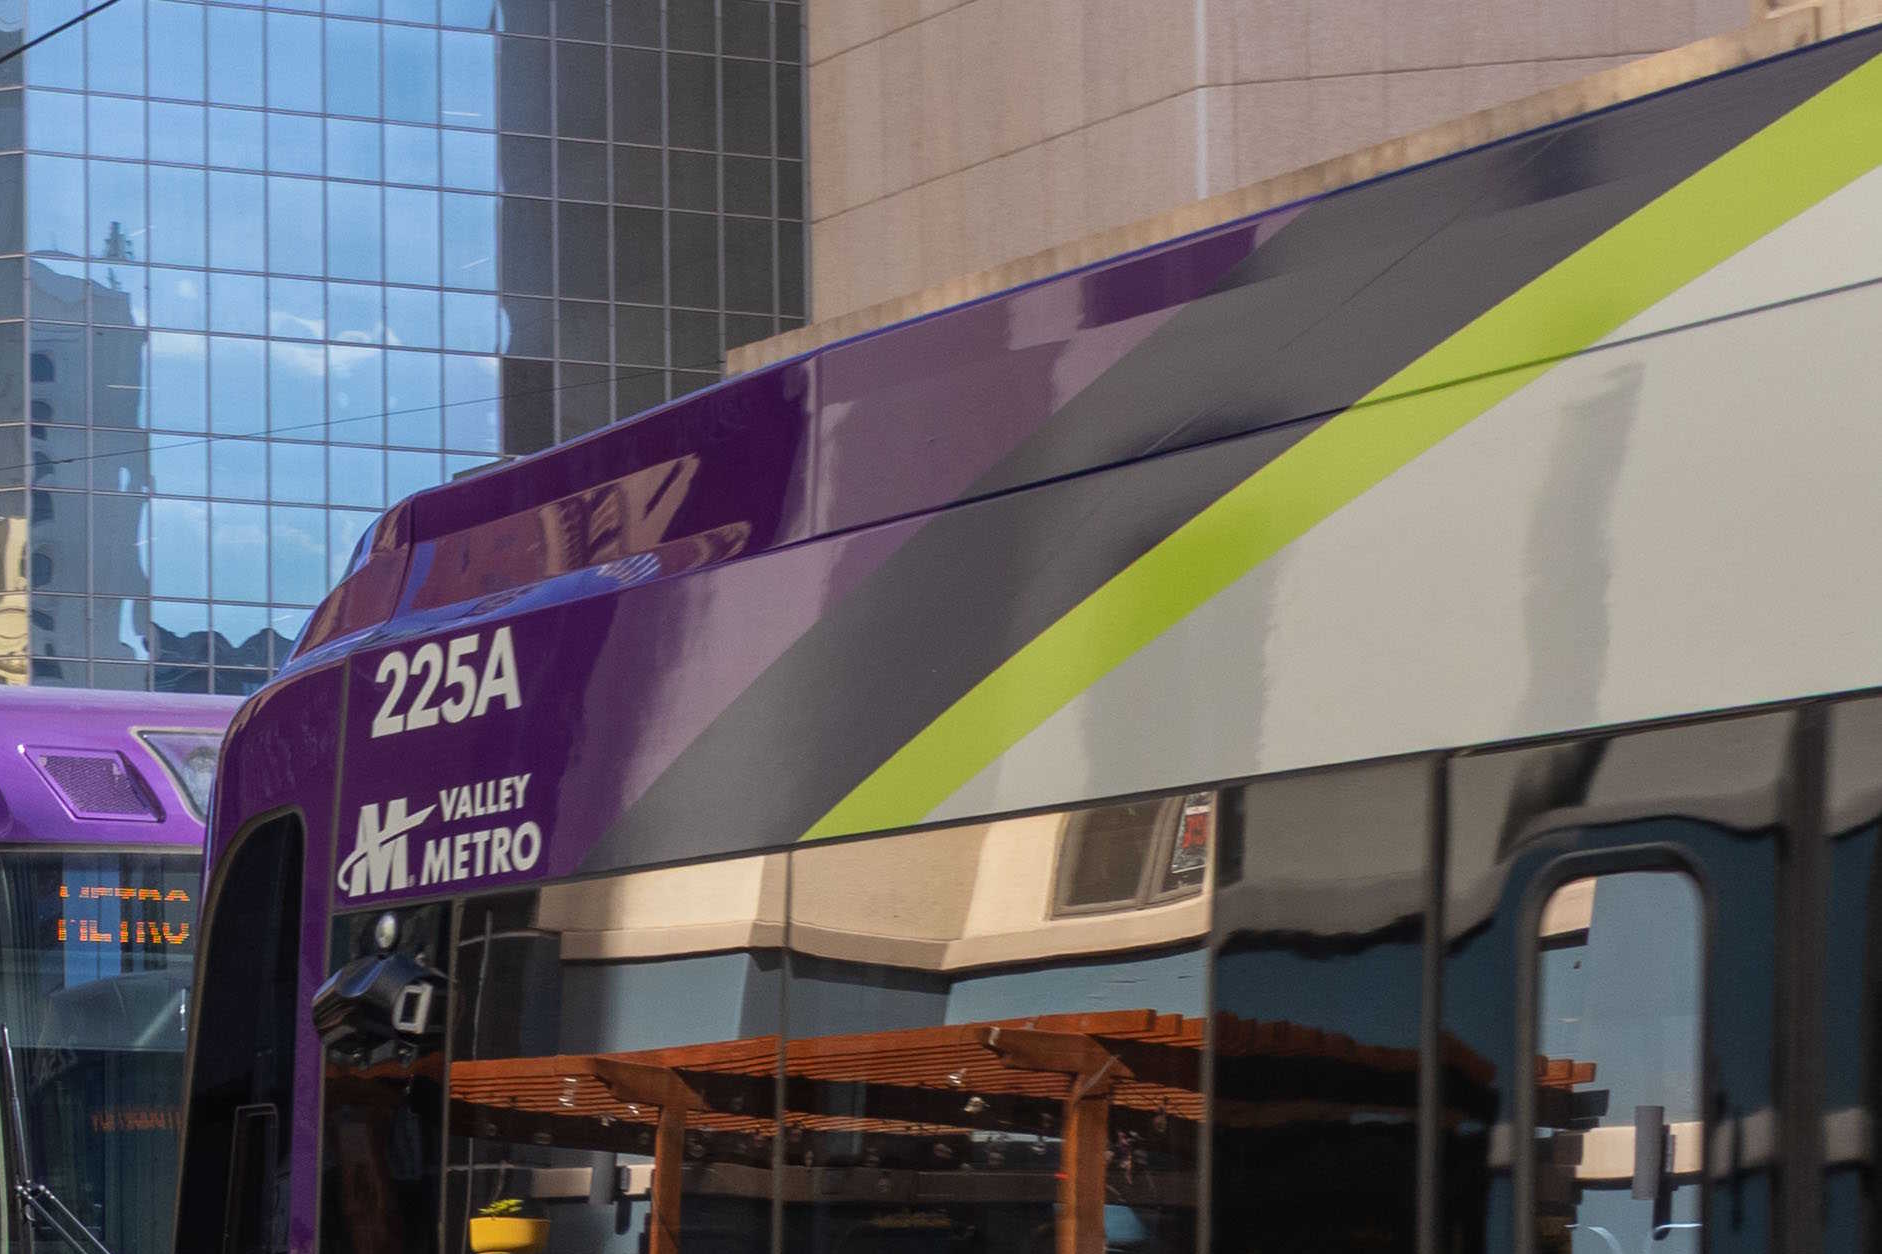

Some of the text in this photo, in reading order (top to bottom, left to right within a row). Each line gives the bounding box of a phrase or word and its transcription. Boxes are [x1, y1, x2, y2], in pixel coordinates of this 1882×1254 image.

[371, 625, 523, 739] 225A
[438, 772, 533, 823] VALLEY
[418, 820, 542, 886] METRO
